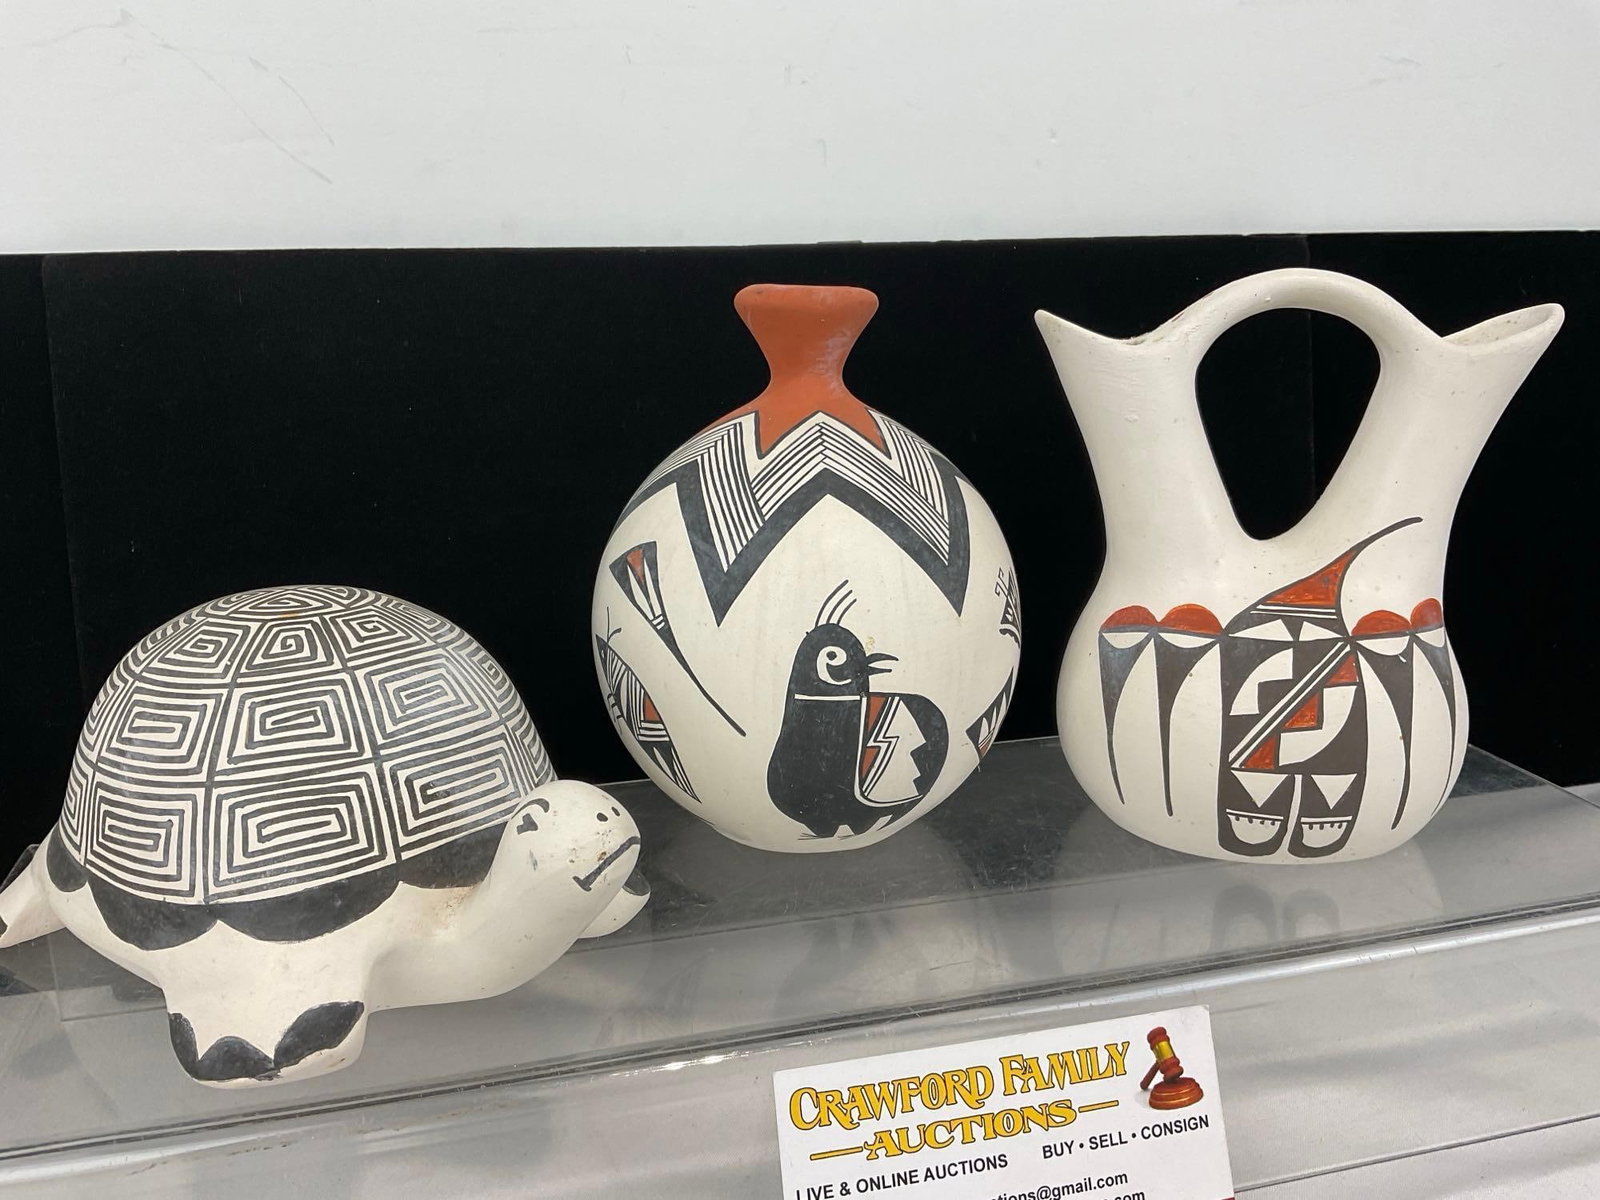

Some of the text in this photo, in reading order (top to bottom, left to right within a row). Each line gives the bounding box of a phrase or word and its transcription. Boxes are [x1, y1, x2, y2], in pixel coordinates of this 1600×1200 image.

[789, 1041, 1130, 1131] CRAWFORD FAMILY
[864, 1099, 1077, 1160] AUCTIONS
[1042, 1114, 1210, 1160] BUY SELL CONSIGN
[796, 1154, 1008, 1200] LIVE & ONLINE AUCTIONS
